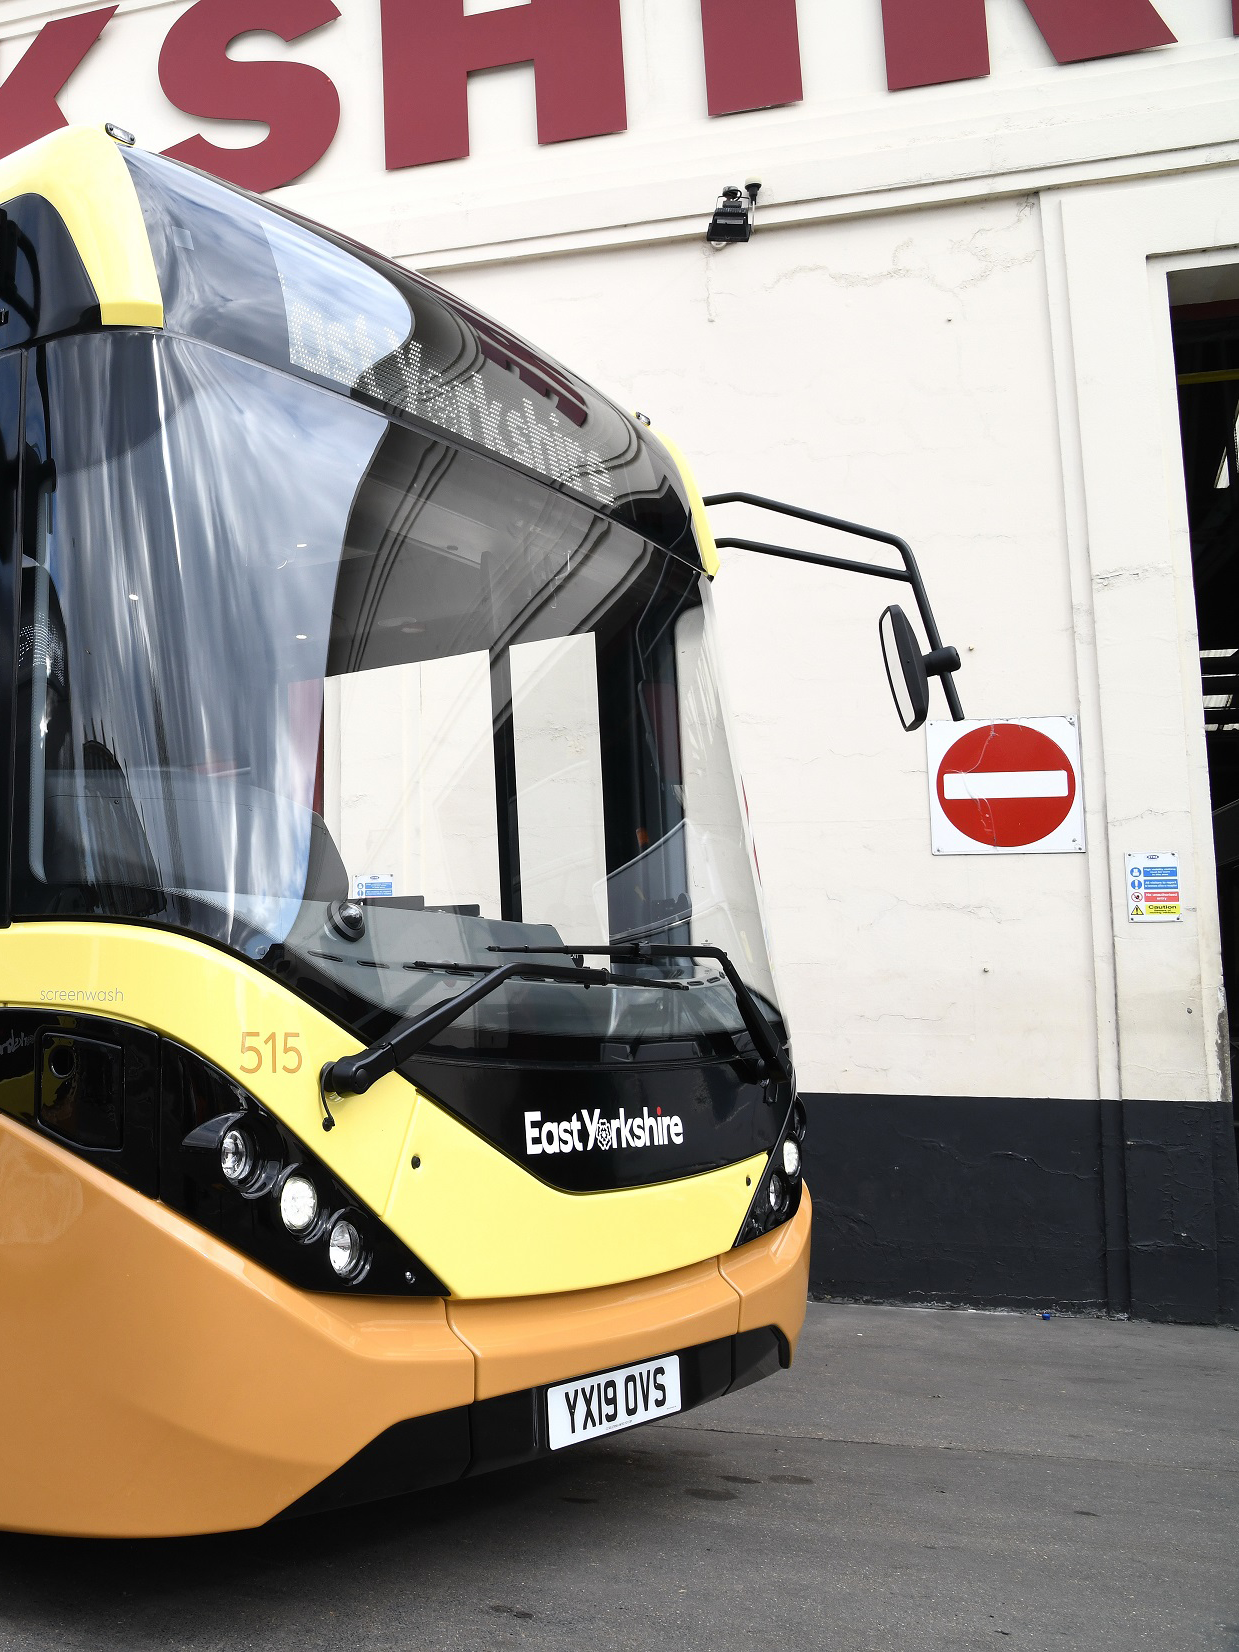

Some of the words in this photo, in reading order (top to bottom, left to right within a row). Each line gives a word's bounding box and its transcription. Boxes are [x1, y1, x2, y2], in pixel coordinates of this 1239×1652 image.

[39, 988, 124, 1002] screenwash
[239, 1031, 303, 1074] 515
[523, 1110, 583, 1155] East
[580, 1105, 684, 1151] Yorkshire
[564, 1379, 618, 1434] YX19
[624, 1366, 667, 1417] OVS
